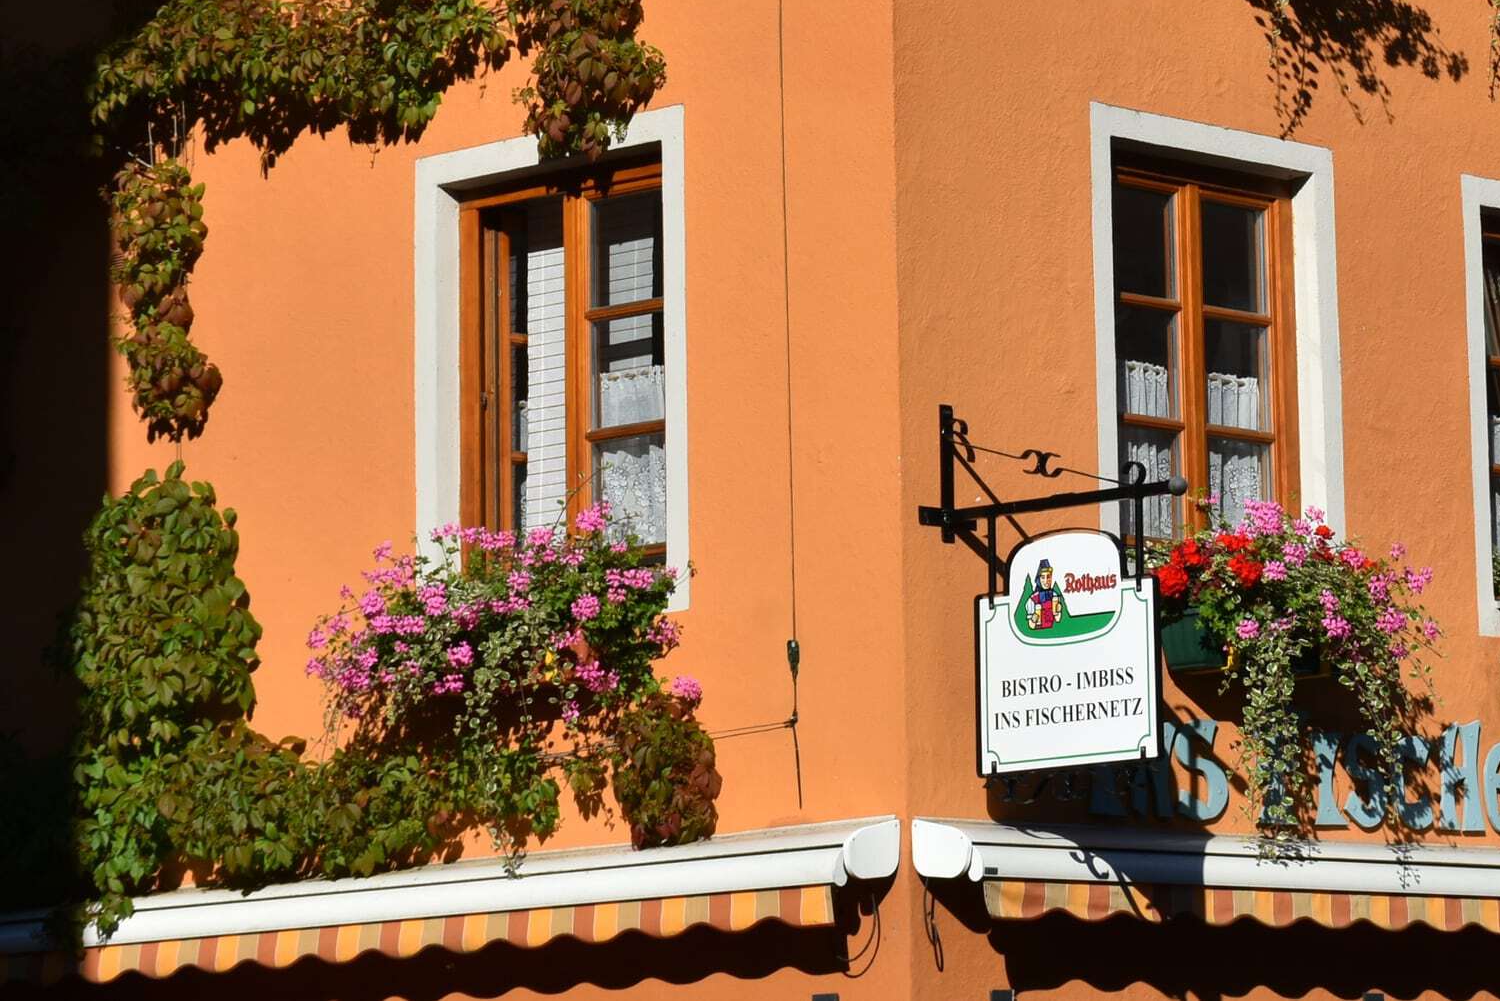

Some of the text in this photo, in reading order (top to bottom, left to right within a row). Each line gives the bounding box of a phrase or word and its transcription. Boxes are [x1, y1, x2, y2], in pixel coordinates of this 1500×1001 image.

[1063, 572, 1117, 595] Rothaus
[1002, 675, 1062, 698] BISTRO
[1077, 666, 1134, 690] IMBISS
[995, 697, 1143, 730] INS FISCHERNETZ
